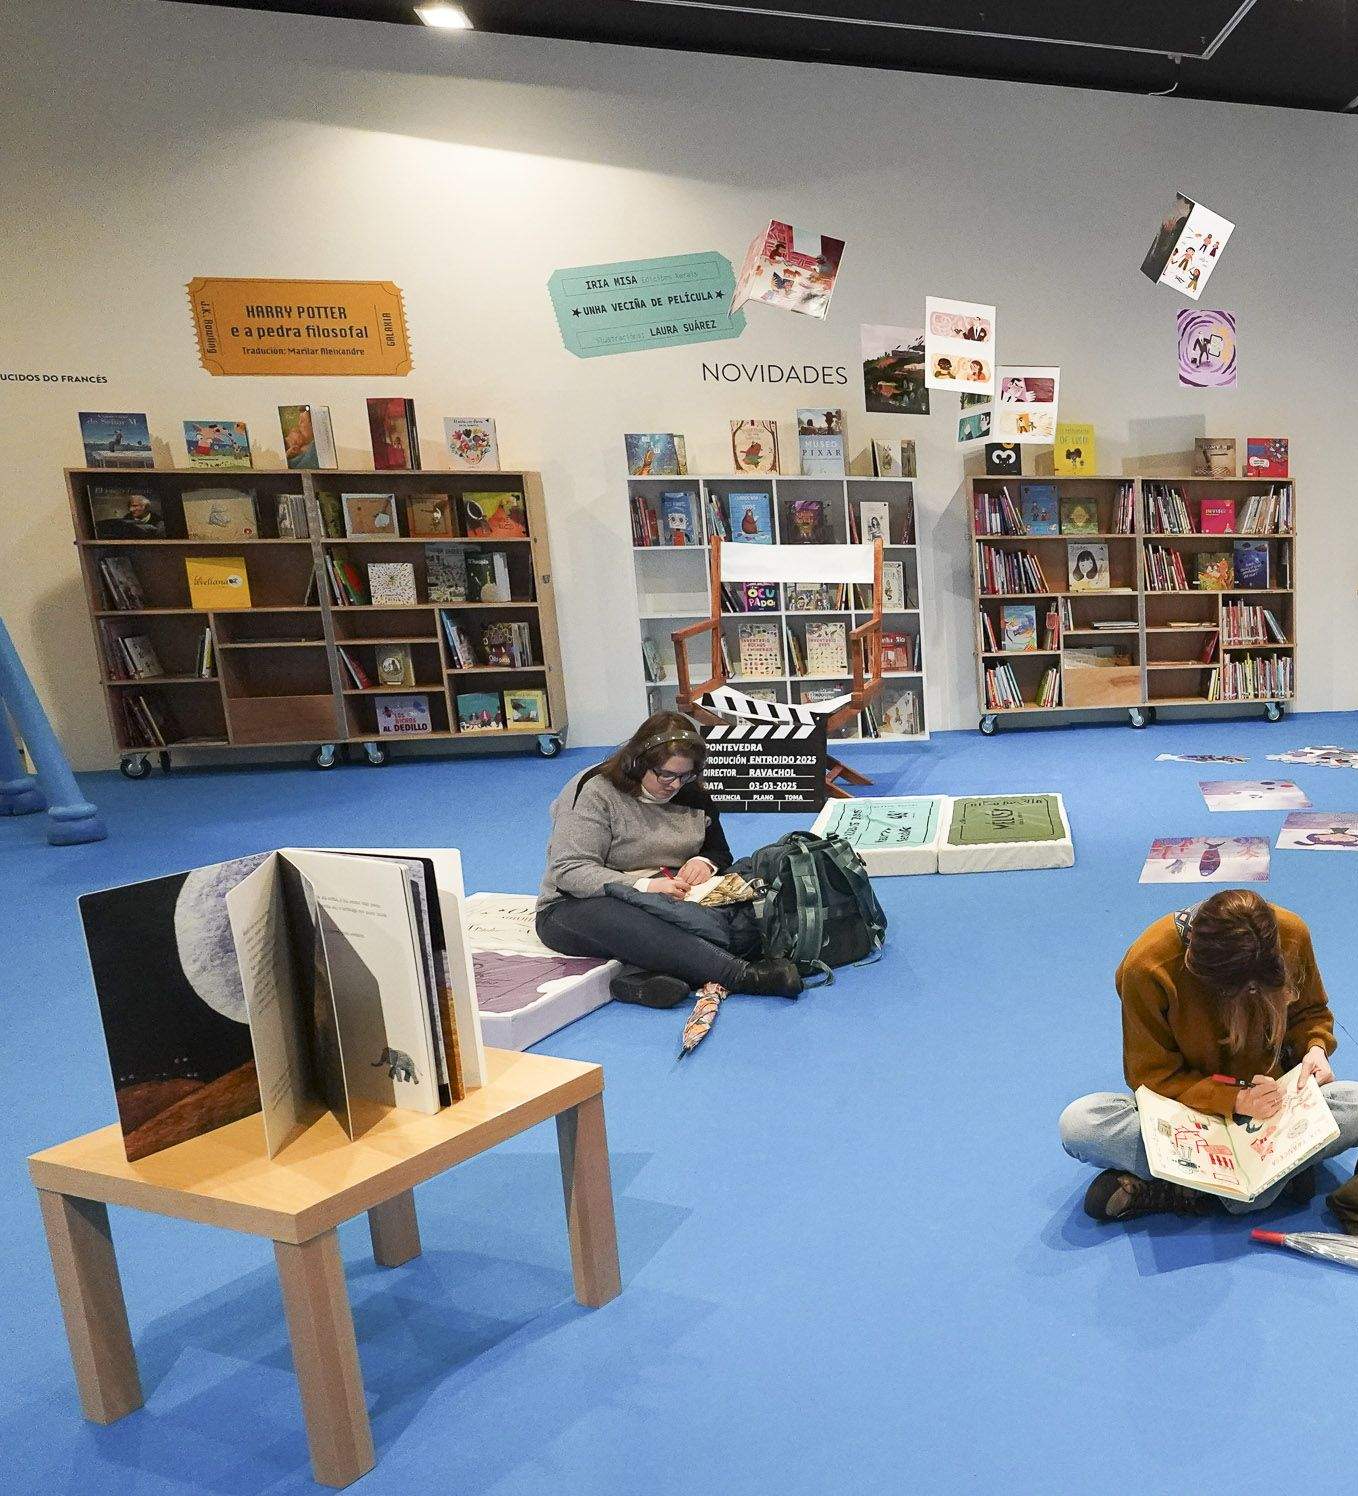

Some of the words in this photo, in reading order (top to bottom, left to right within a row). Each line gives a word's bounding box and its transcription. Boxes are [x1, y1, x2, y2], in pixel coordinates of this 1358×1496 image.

[585, 278, 610, 290] IRIA
[614, 275, 638, 287] MISA
[583, 304, 607, 316] UNHA
[612, 297, 648, 312] VECIÑA
[651, 297, 663, 308] DE
[668, 290, 714, 305] PELÍCULA
[246, 305, 292, 319] HARRY
[298, 306, 347, 320] POTTER
[230, 327, 240, 338] e
[244, 328, 253, 338] a
[257, 325, 301, 340] pedra
[305, 325, 369, 339] filosofal
[382, 312, 395, 347] GALAXIA
[650, 325, 679, 337] LAURA
[683, 319, 717, 333] SUÁREZ
[43, 374, 59, 383] DO
[61, 374, 108, 384] FRANCÉS
[702, 362, 848, 385] NOVIDADES
[803, 449, 841, 457] PIXAR
[394, 723, 428, 732] DEDILLO
[705, 743, 763, 752] PONTEVEDRA
[705, 754, 747, 765] RODUCIÓN
[749, 755, 795, 765] ENTROIDO
[797, 755, 817, 765] 2025
[703, 769, 737, 777] DIRECTOR
[749, 768, 797, 777] RAVACHOL
[749, 781, 798, 790] 03-03-2025
